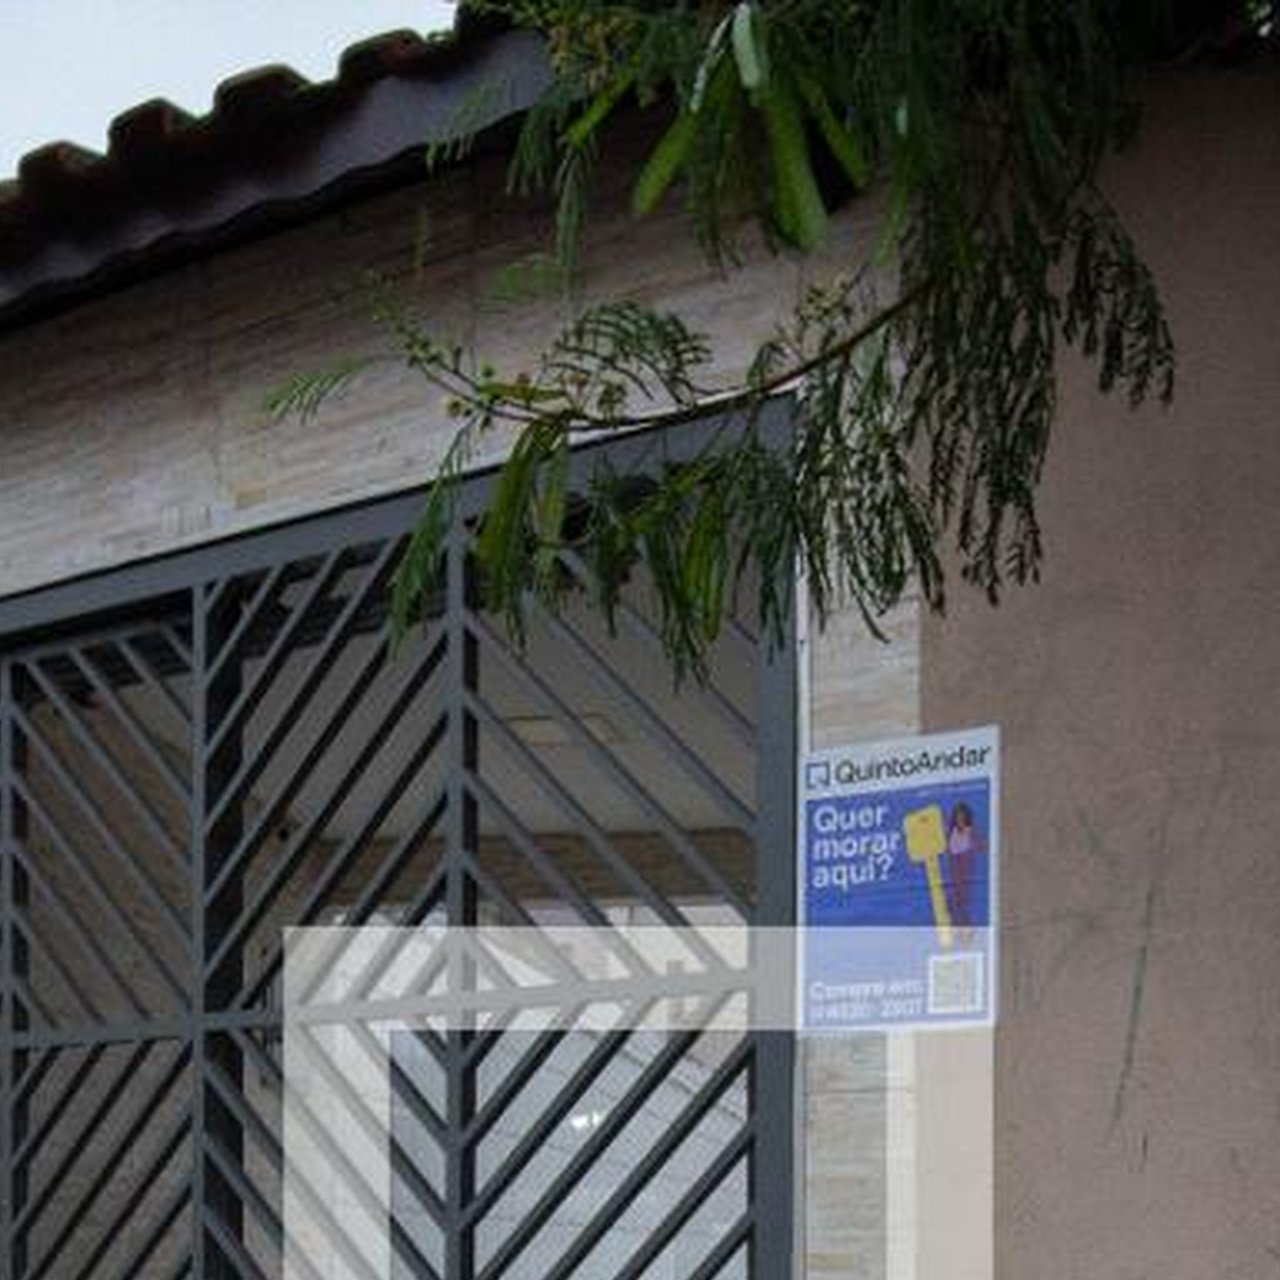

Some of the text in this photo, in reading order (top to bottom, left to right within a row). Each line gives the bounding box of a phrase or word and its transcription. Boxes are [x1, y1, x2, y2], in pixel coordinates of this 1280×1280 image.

[835, 745, 991, 785] QuintoAndar
[813, 804, 888, 832] Quer
[812, 831, 900, 860] morar
[812, 853, 894, 892] aqui?
